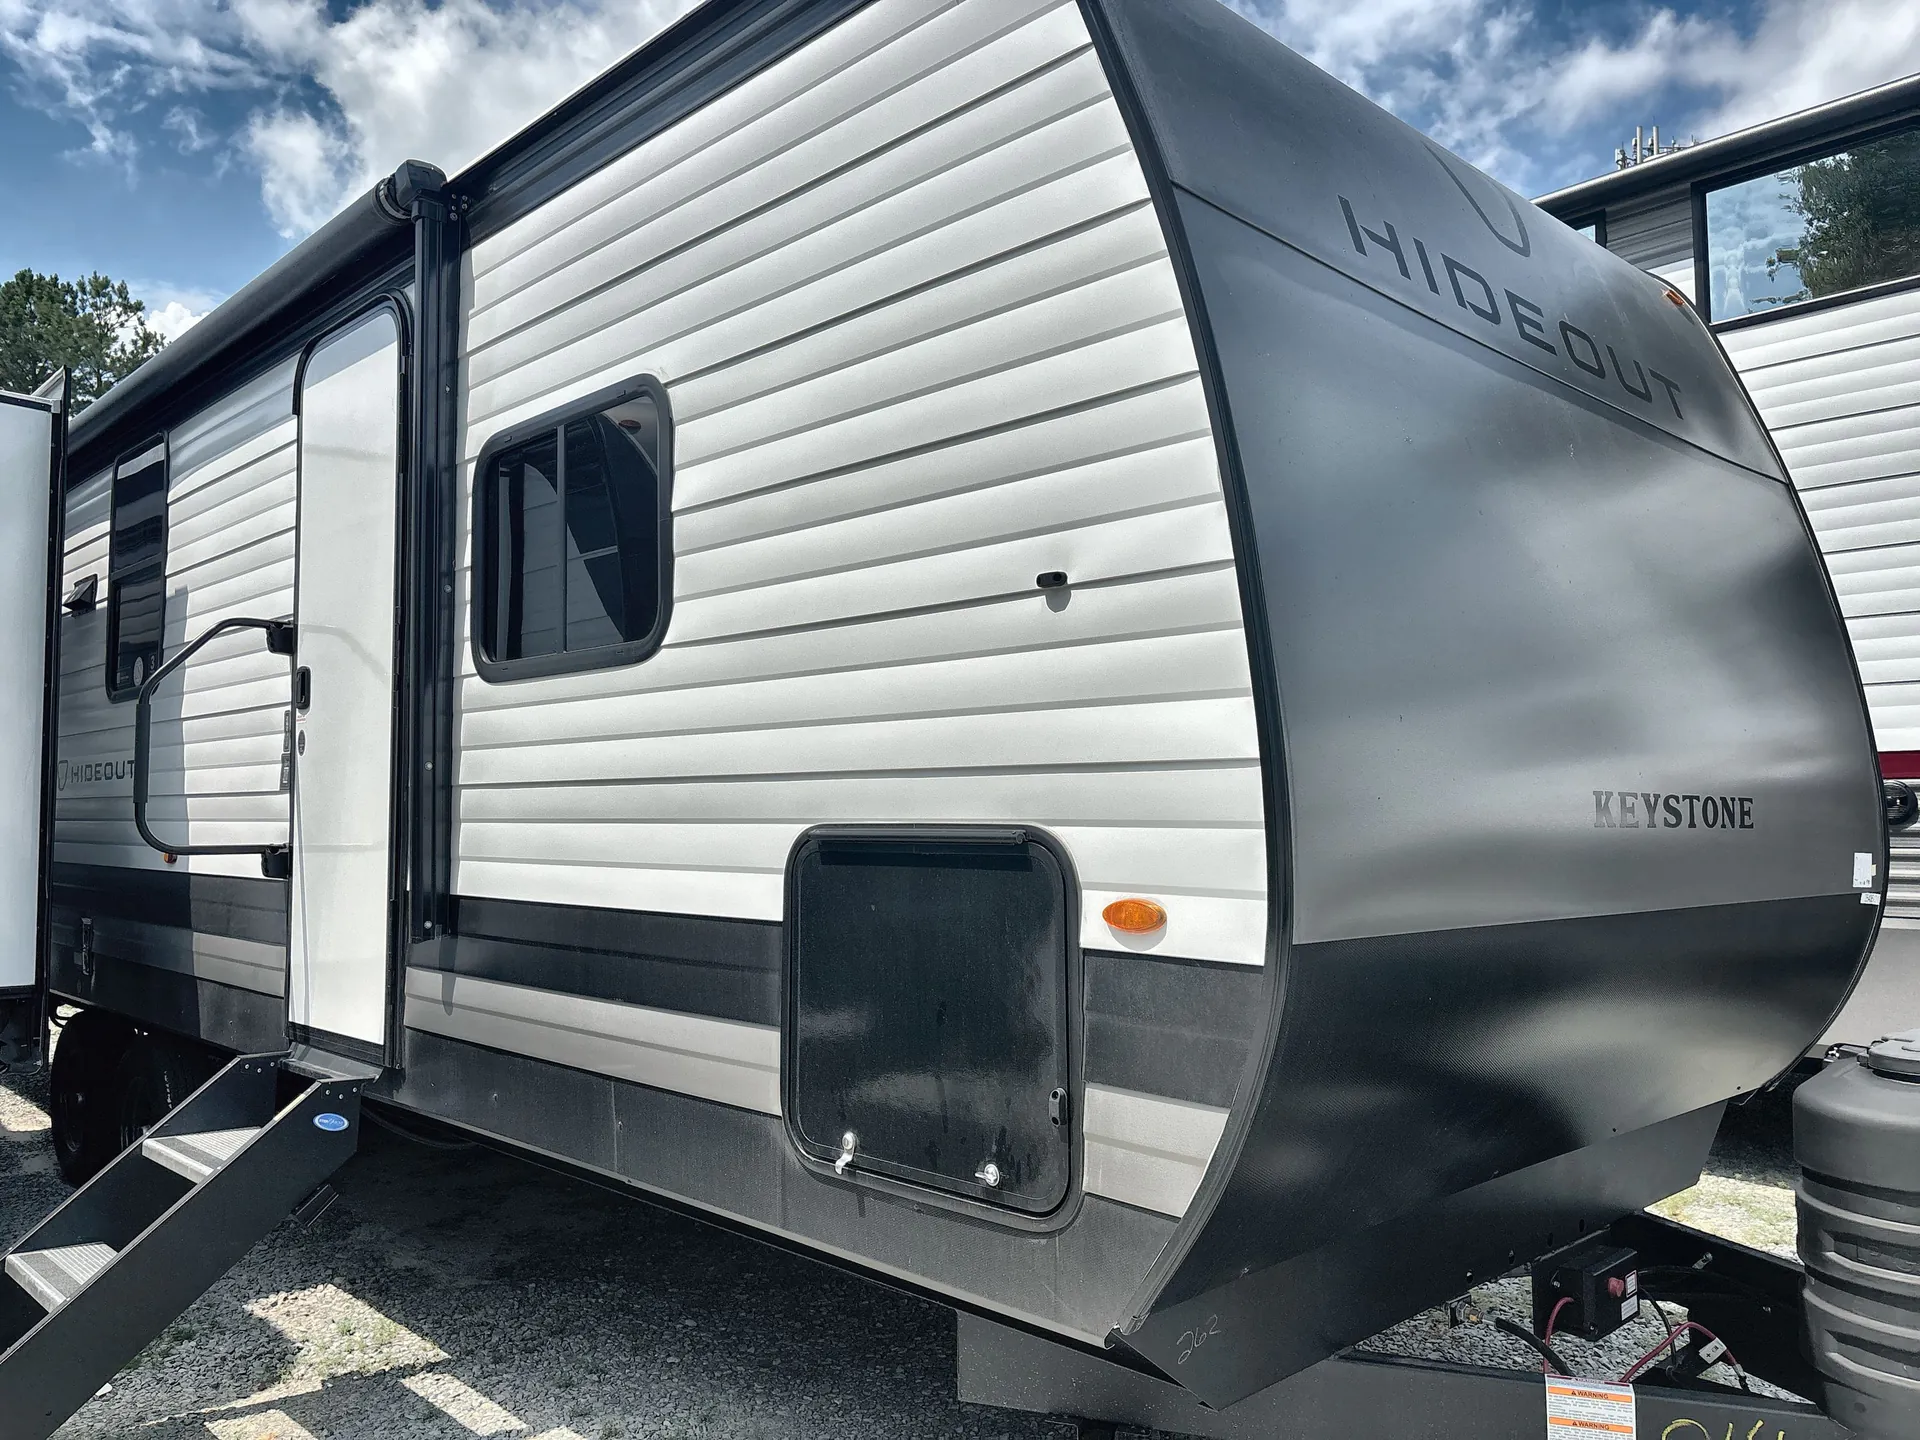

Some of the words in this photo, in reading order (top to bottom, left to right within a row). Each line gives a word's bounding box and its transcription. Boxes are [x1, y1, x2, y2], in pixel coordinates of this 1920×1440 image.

[1337, 194, 1683, 420] HIDEOUT
[71, 760, 135, 783] HIDEOUT
[1592, 790, 1754, 829] KEYSTONE
[1176, 1314, 1221, 1365] 262
[1577, 1390, 1609, 1400] WARNING
[1578, 1420, 1610, 1431] WARNING
